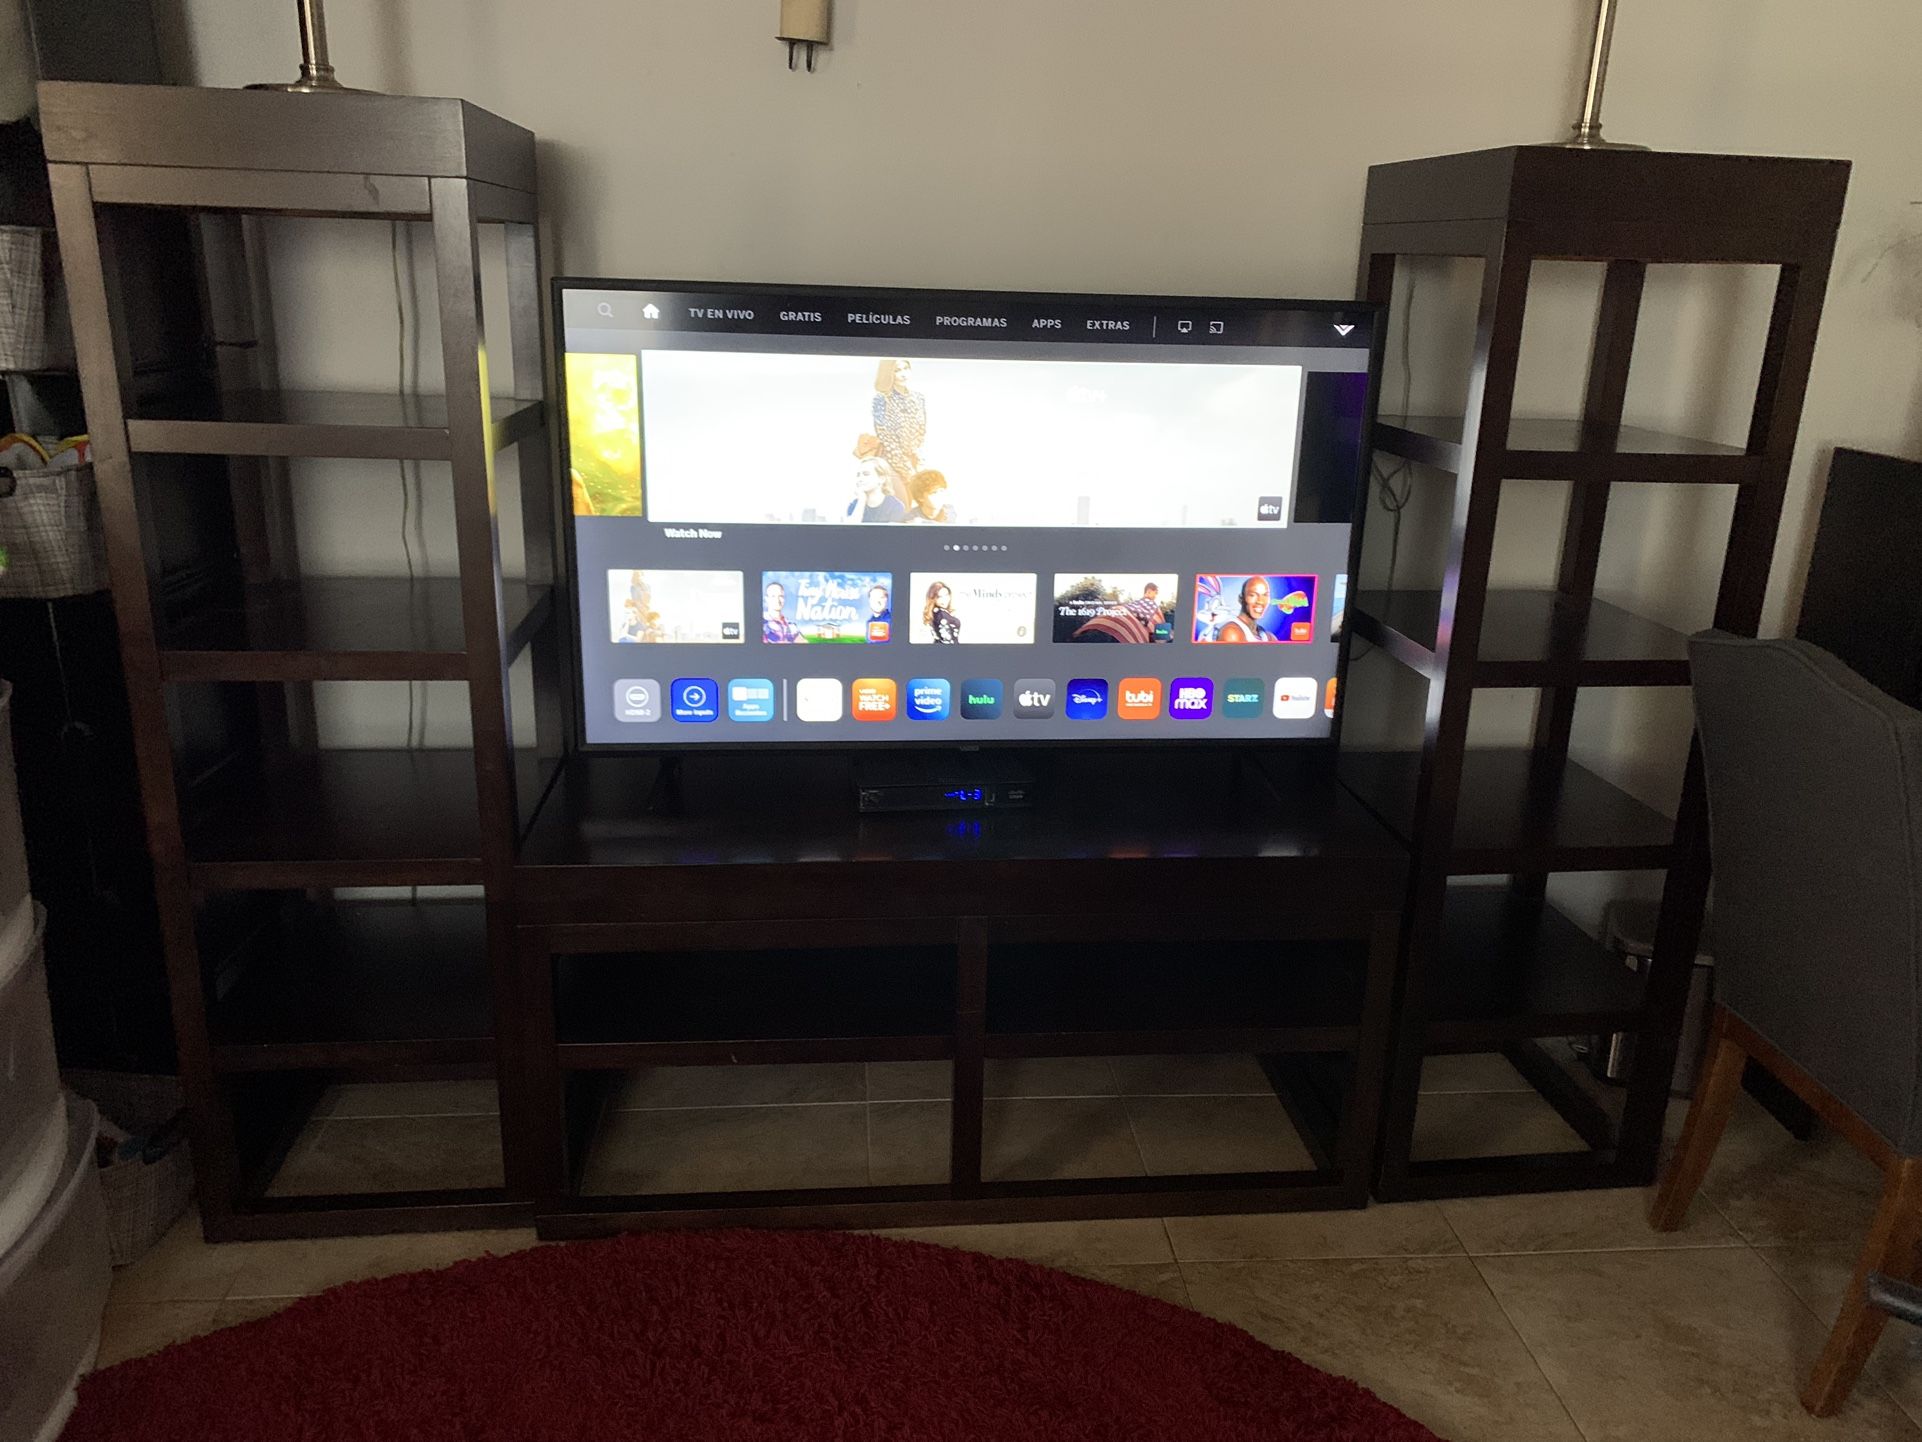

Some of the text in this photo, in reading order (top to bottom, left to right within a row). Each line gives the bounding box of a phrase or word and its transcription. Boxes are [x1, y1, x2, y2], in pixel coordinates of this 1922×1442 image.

[688, 308, 754, 320] TV EN VIVO
[779, 311, 822, 322] GRATIS
[847, 312, 911, 325] PELÍCULAS
[936, 316, 1008, 328] PROGRAMAS
[1032, 318, 1062, 329] APPS
[1086, 320, 1130, 330] EXTRAS
[664, 528, 722, 539] Watch Now
[796, 598, 859, 620] Nation
[1058, 606, 1127, 617] The 1619 Project
[914, 686, 942, 697] prime
[1125, 690, 1154, 703] tubi
[1178, 688, 1207, 699] HBO
[859, 694, 889, 702] WATCH
[914, 696, 942, 705] video
[968, 694, 995, 704] hulu
[1227, 694, 1258, 703] STARZ
[1174, 698, 1208, 710] max
